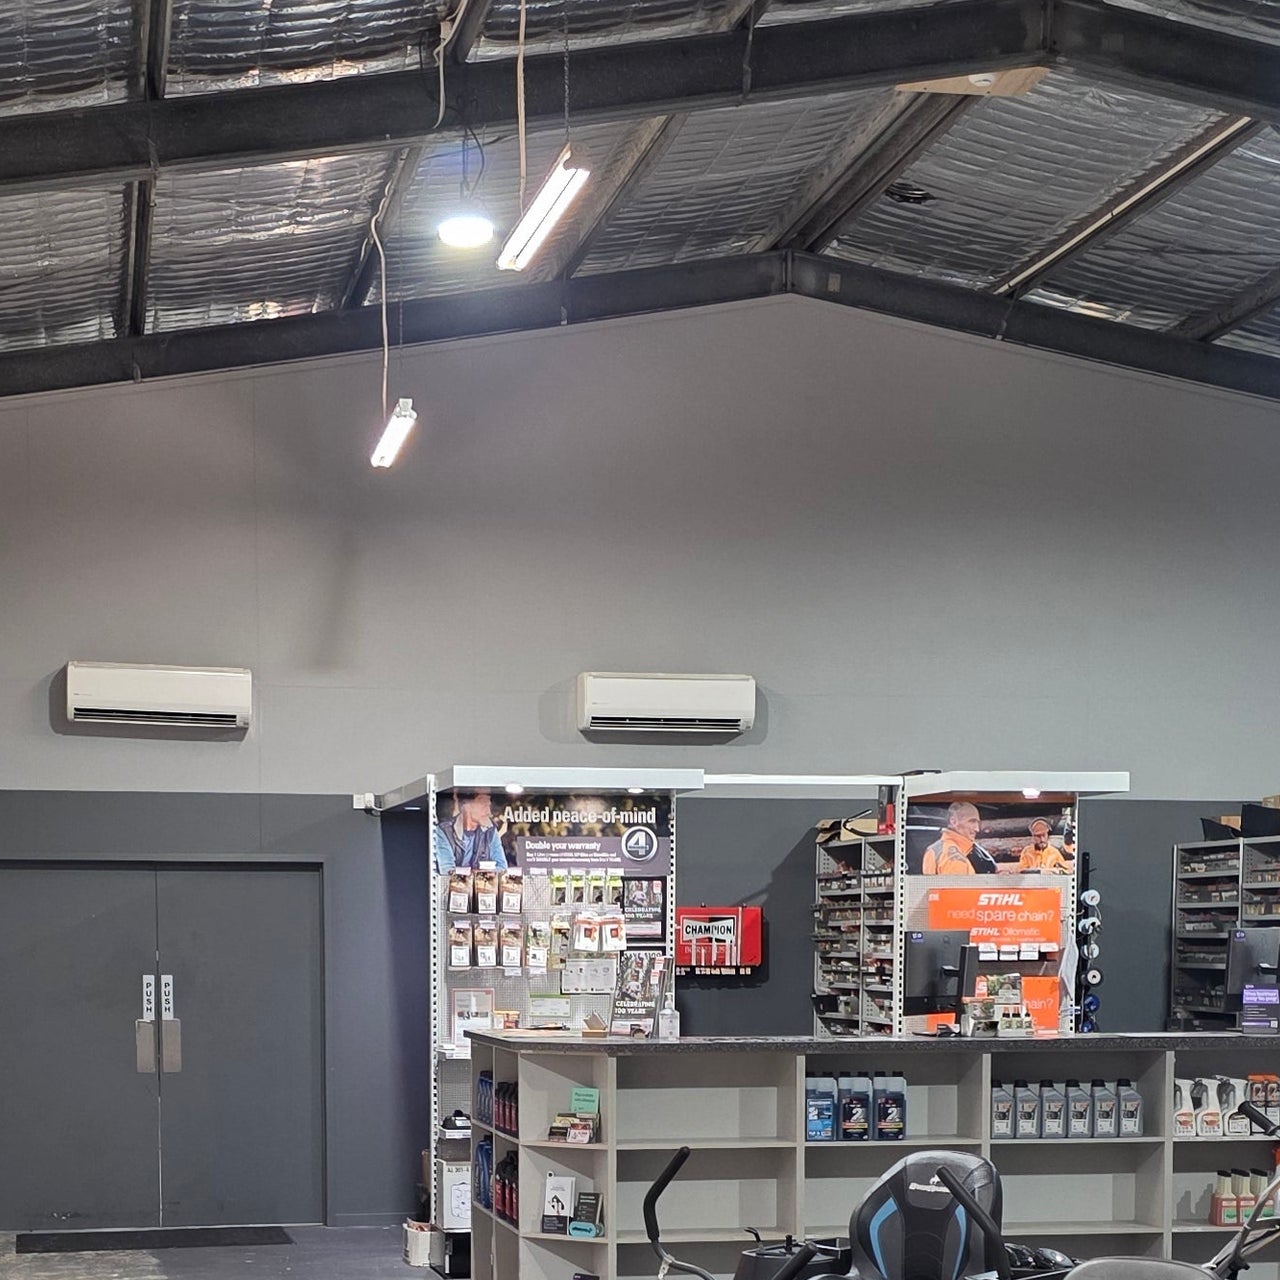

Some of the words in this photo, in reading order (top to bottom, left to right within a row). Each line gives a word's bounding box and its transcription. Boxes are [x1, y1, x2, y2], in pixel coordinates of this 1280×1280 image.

[503, 806, 549, 823] Added
[553, 806, 656, 827] peace-of-mind
[568, 841, 601, 852] warranty
[978, 893, 1023, 906] STIHL
[947, 909, 975, 919] need
[976, 910, 1016, 923] spare
[1018, 909, 1054, 921] chain?
[971, 928, 1000, 936] STIHL
